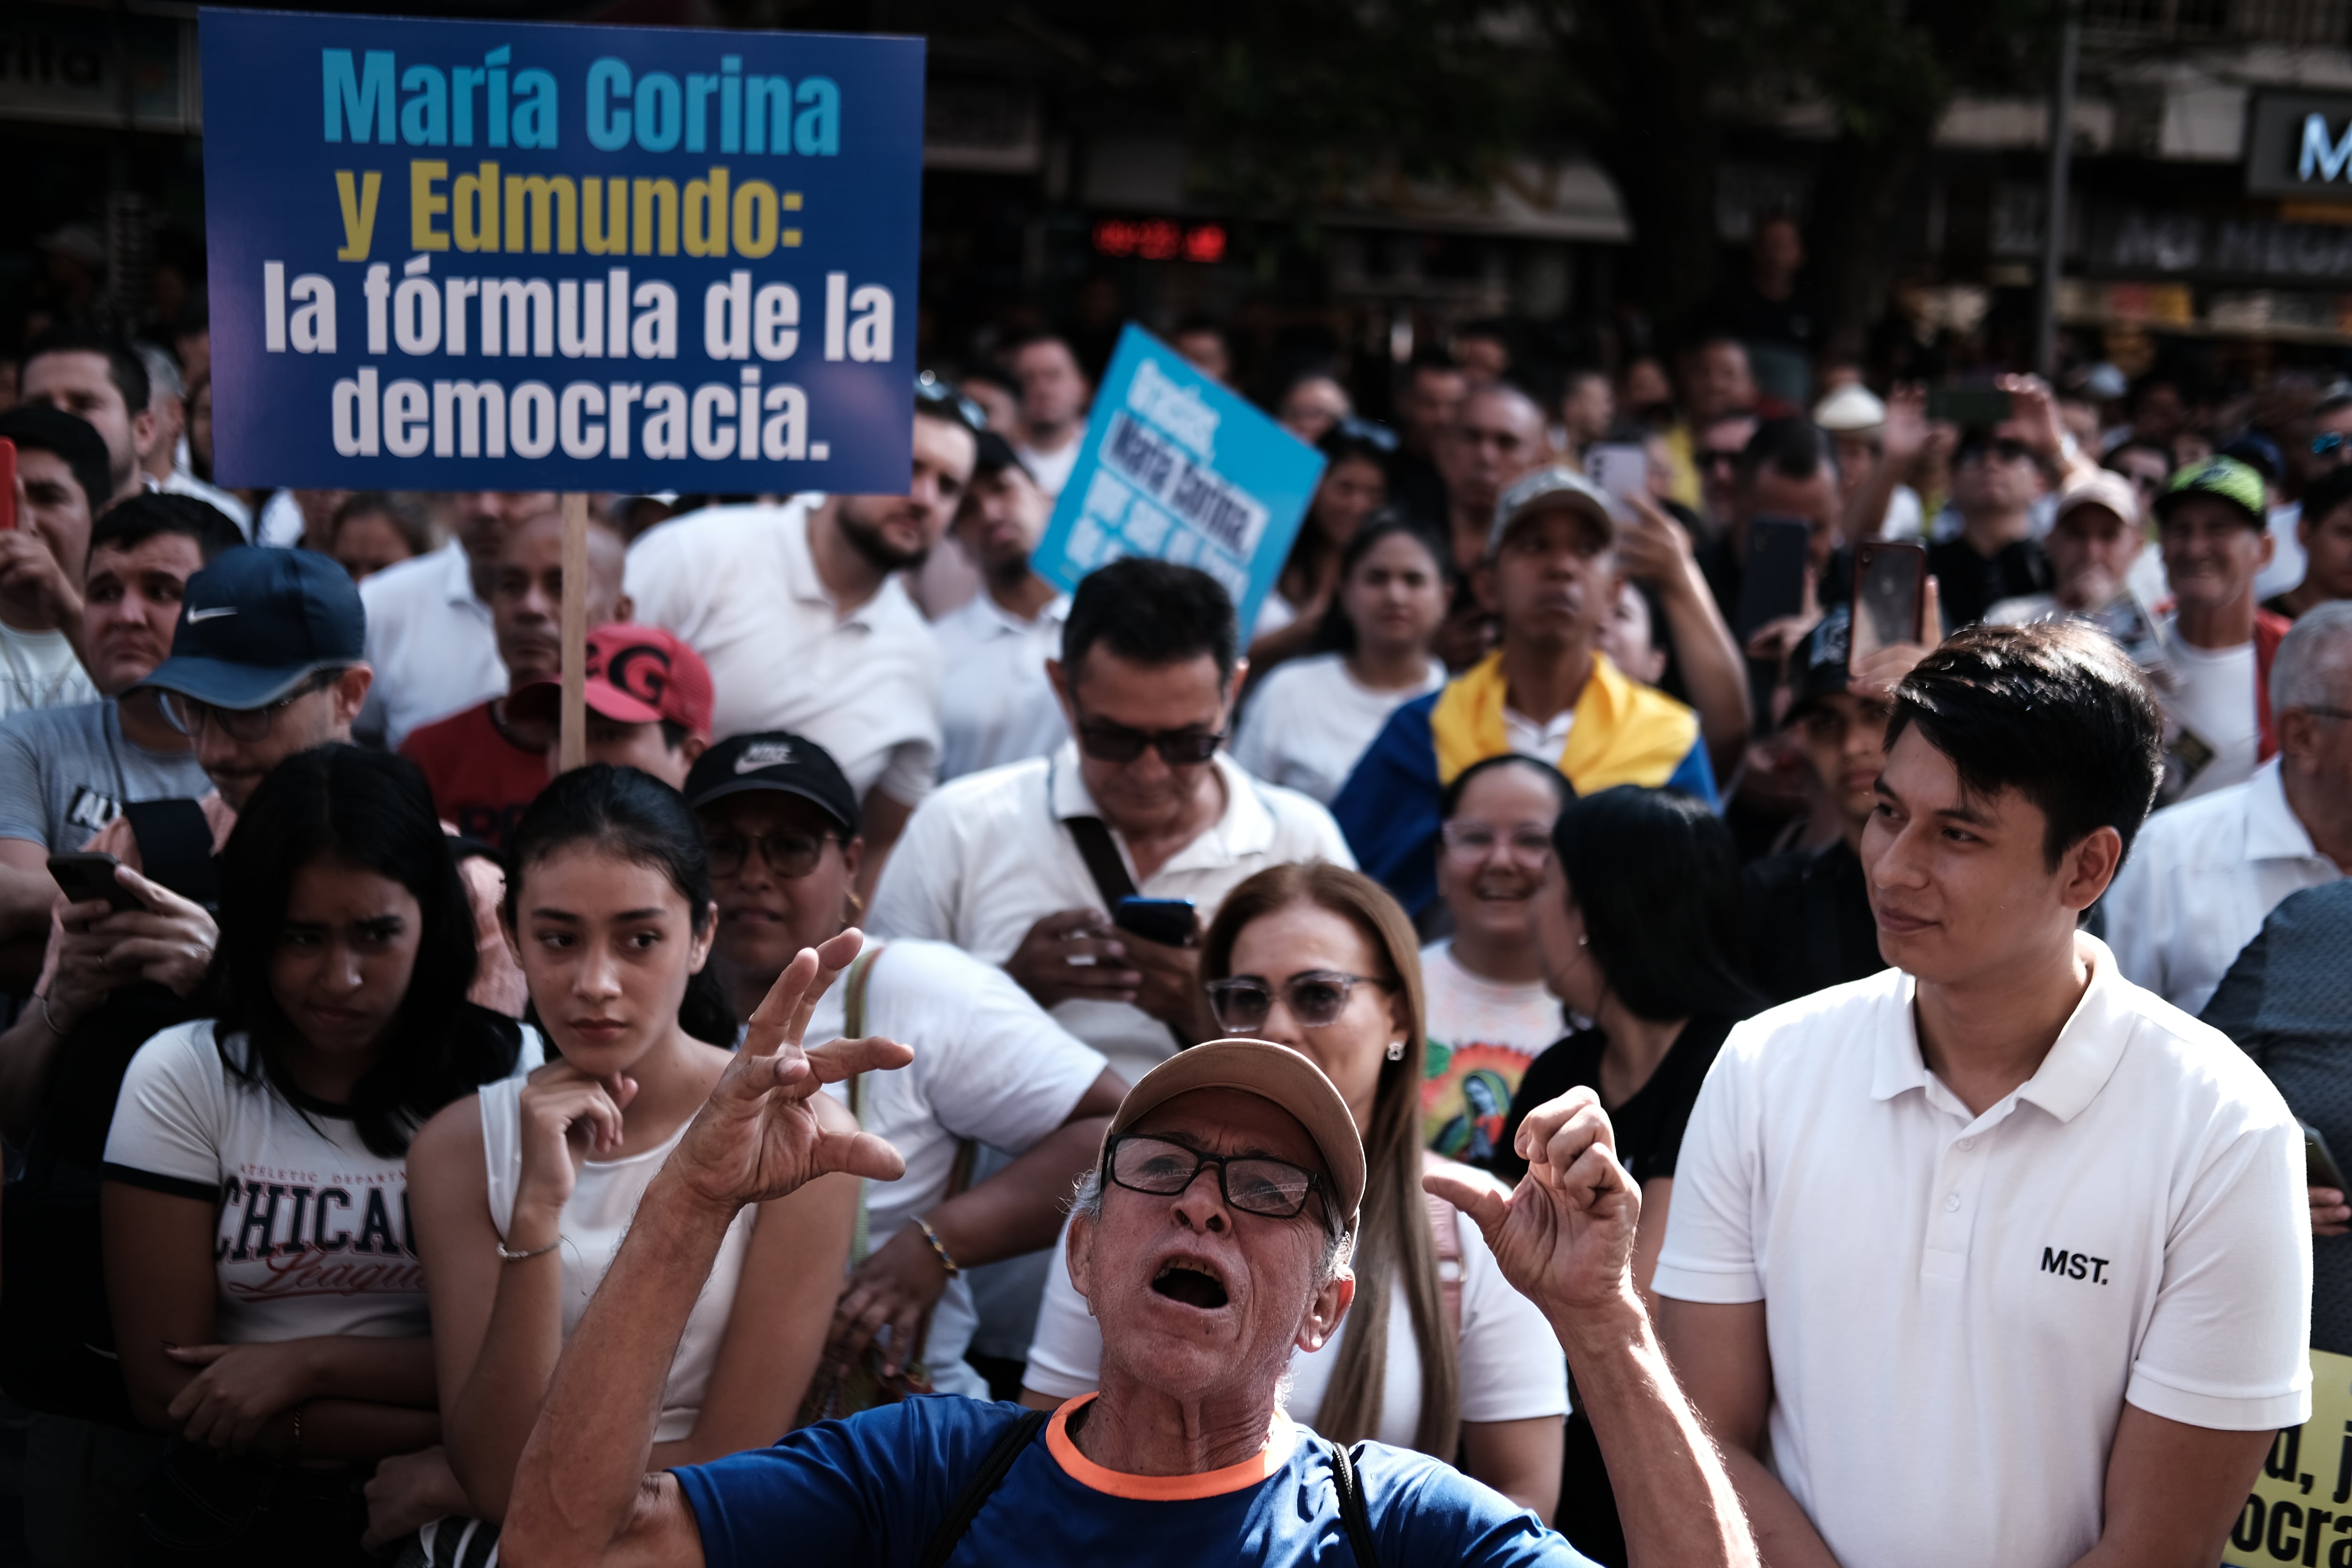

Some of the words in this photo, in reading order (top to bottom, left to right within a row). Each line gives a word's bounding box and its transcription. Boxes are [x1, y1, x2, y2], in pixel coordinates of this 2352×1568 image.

[322, 44, 558, 148] María
[586, 55, 840, 156] Corina
[335, 170, 382, 262] y
[410, 159, 803, 258] Edmundo:
[264, 260, 337, 354] la
[365, 254, 677, 358] fórmula
[705, 270, 801, 361] de
[824, 271, 894, 362] la
[332, 366, 829, 461] democracia.
[240, 1164, 318, 1183] ATHLETIC
[2041, 1247, 2110, 1285] MST.
